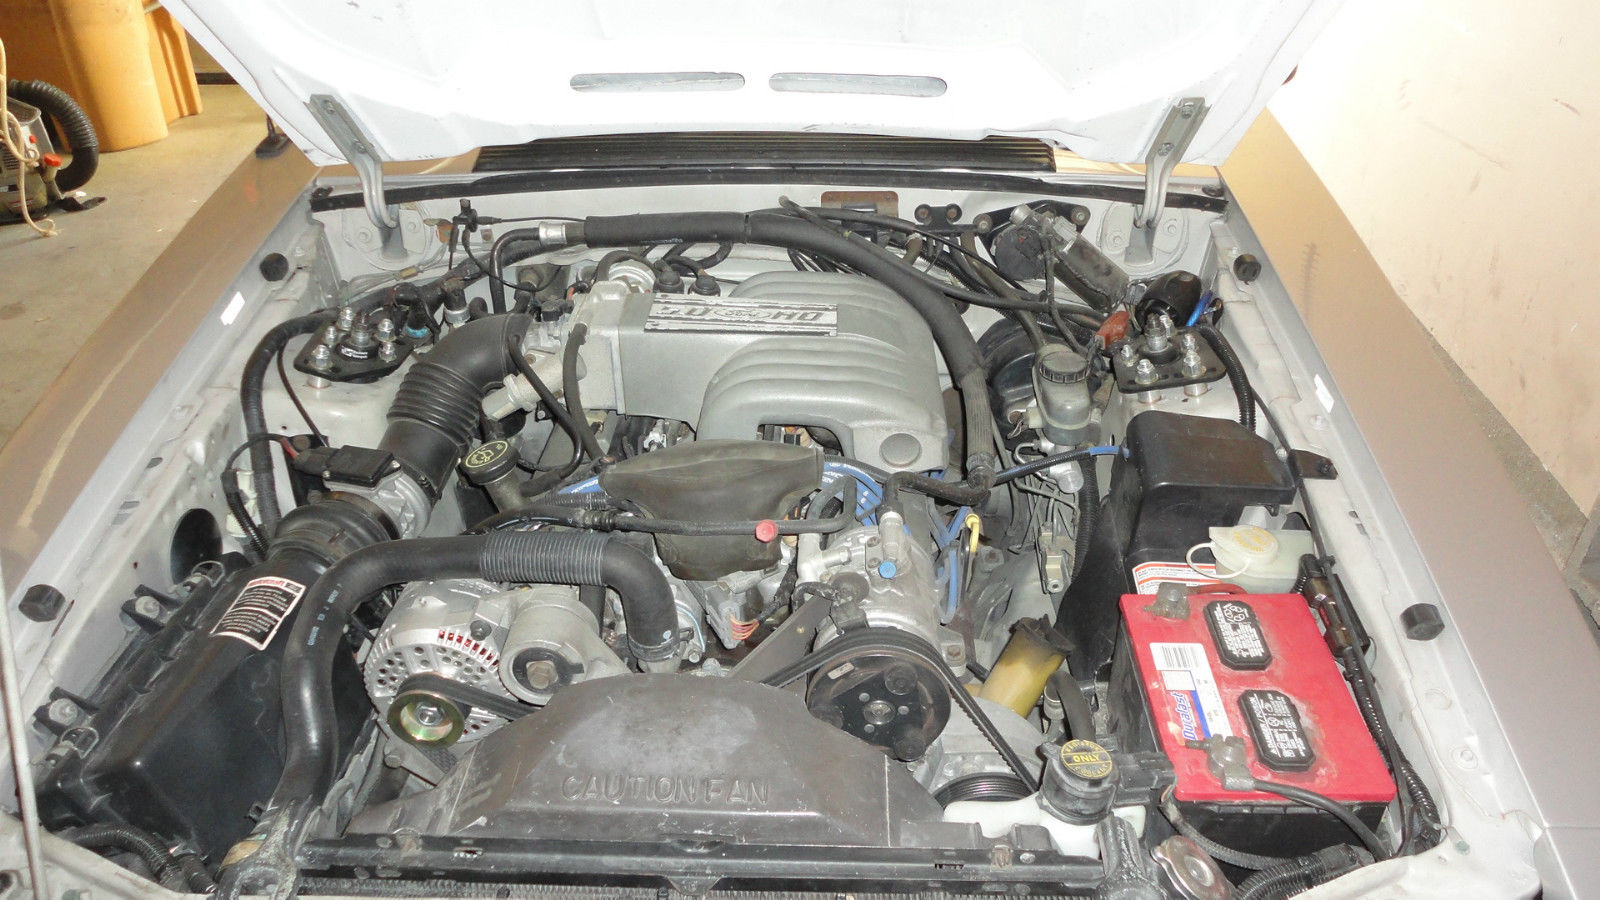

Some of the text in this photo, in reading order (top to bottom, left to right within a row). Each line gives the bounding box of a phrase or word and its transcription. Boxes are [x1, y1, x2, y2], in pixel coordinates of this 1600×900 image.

[1170, 691, 1198, 741] Duralast
[1073, 754, 1099, 762] ONLY
[561, 774, 769, 805] CAUTION FAN
